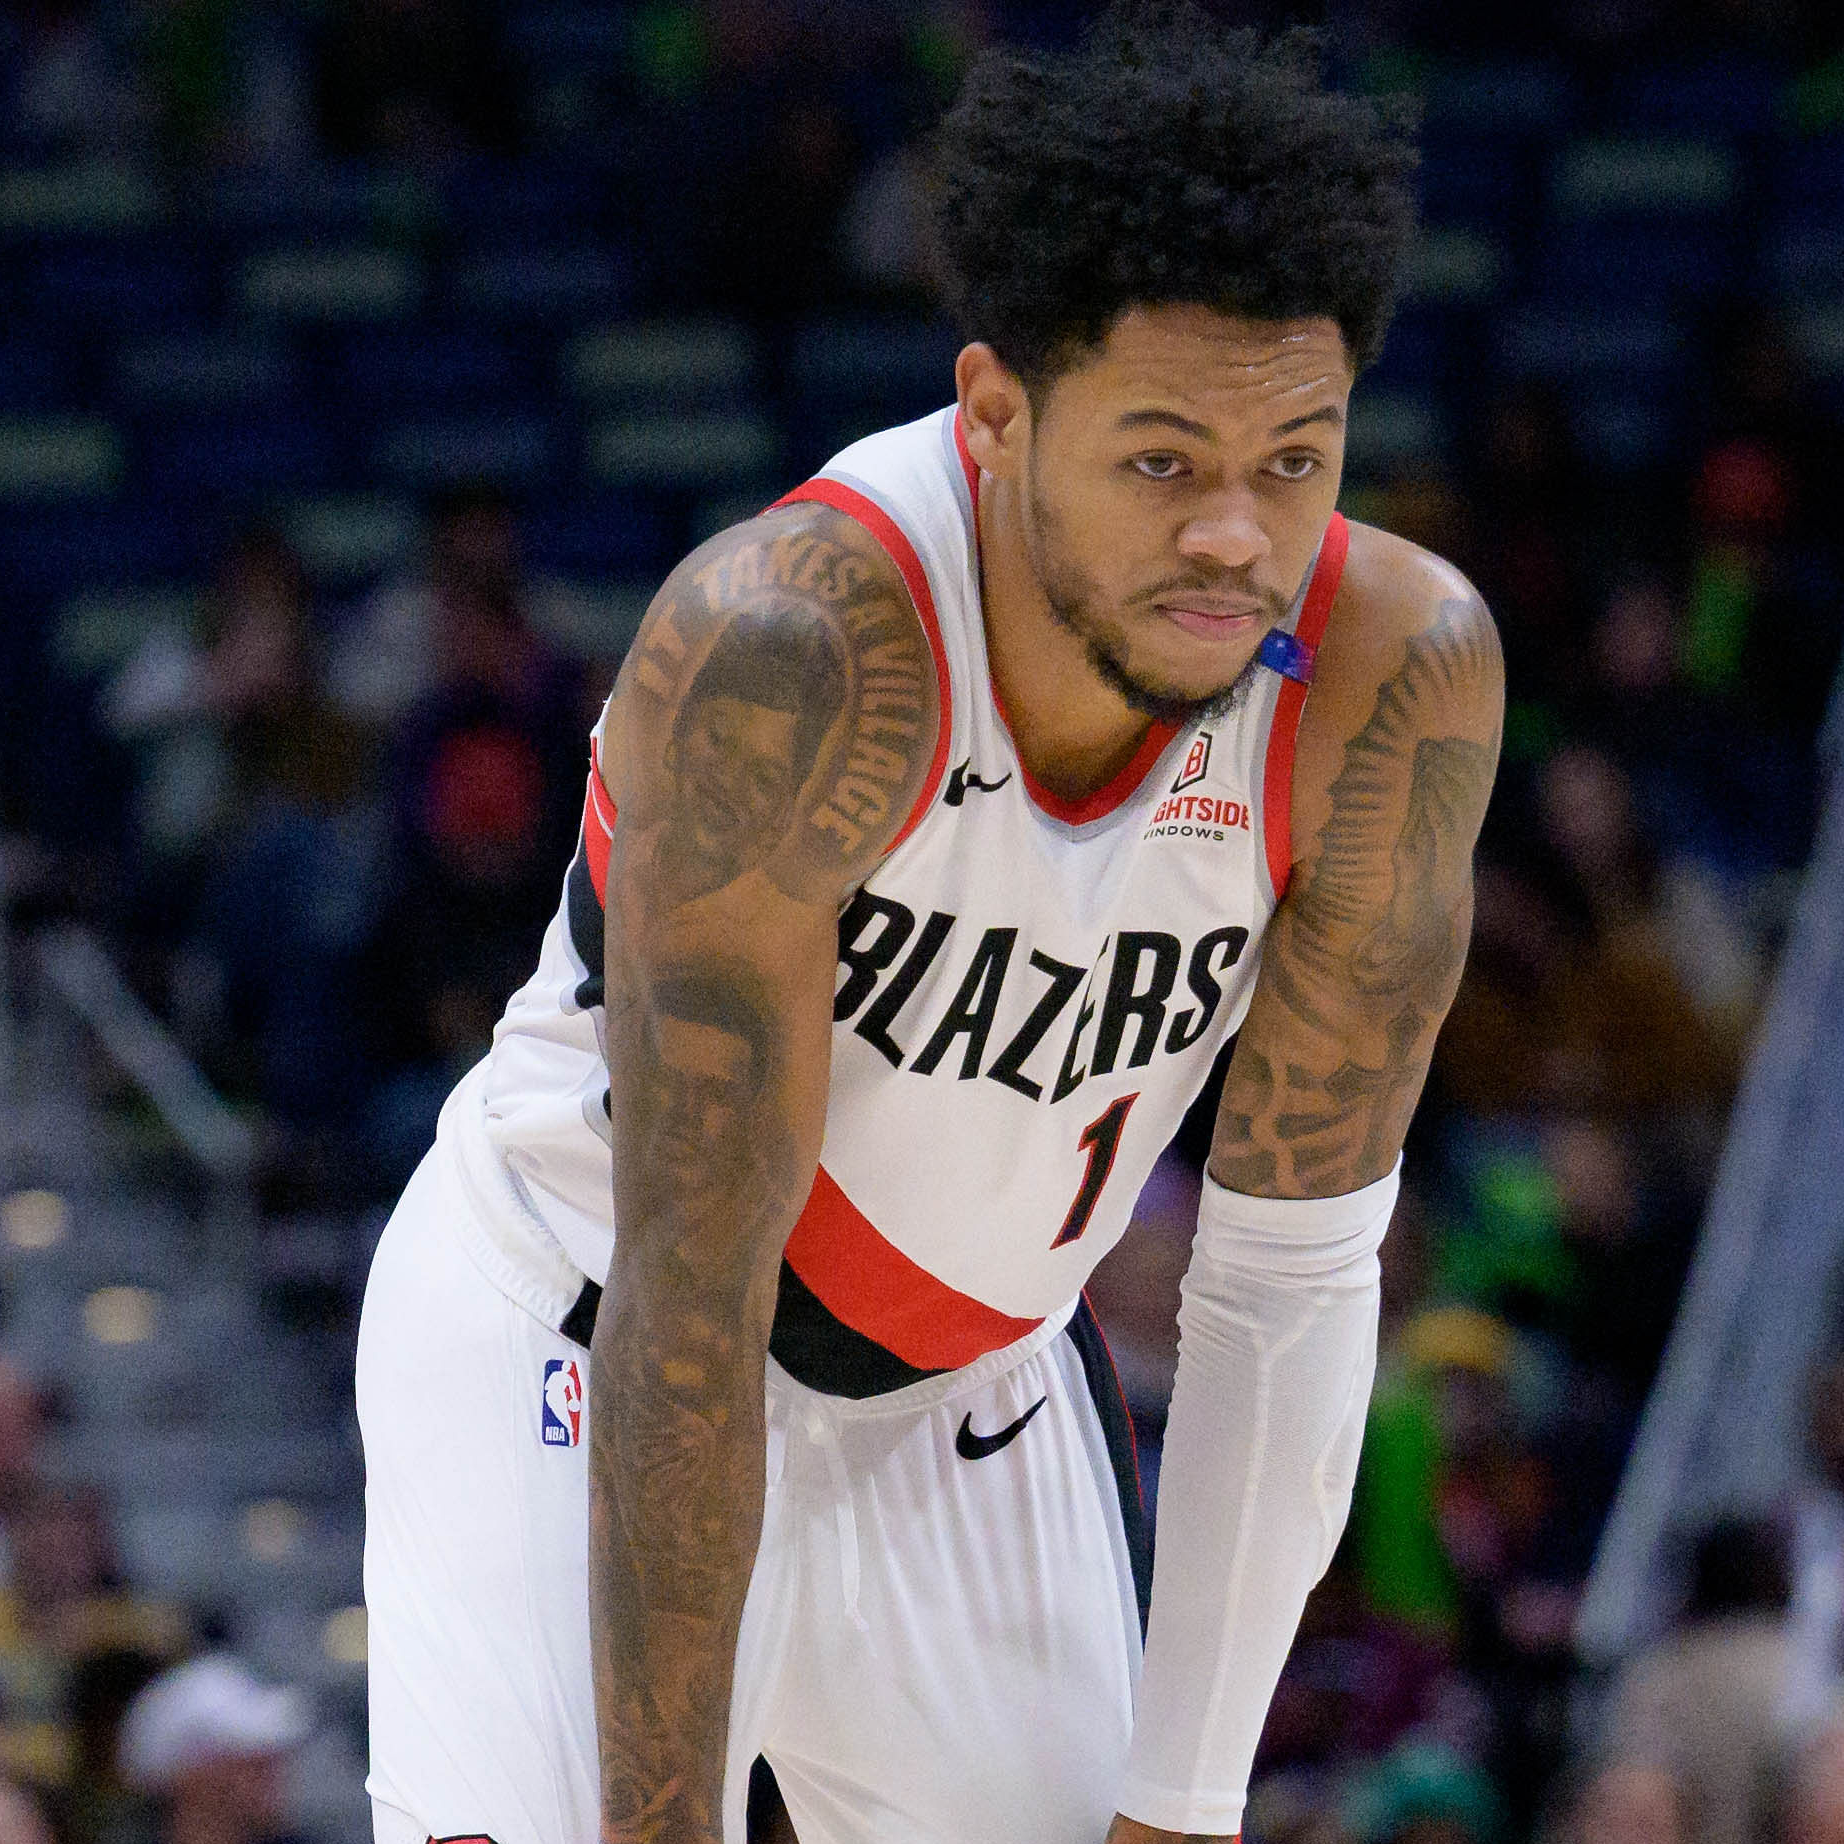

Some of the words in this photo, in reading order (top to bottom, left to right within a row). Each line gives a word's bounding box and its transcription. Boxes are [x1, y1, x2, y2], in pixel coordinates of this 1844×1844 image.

[1182, 740, 1205, 780] B
[1149, 795, 1250, 832] GHTSIDE
[832, 886, 1249, 1105] BLAZERS
[1049, 1091, 1141, 1250] 1
[545, 1425, 566, 1442] NBA
